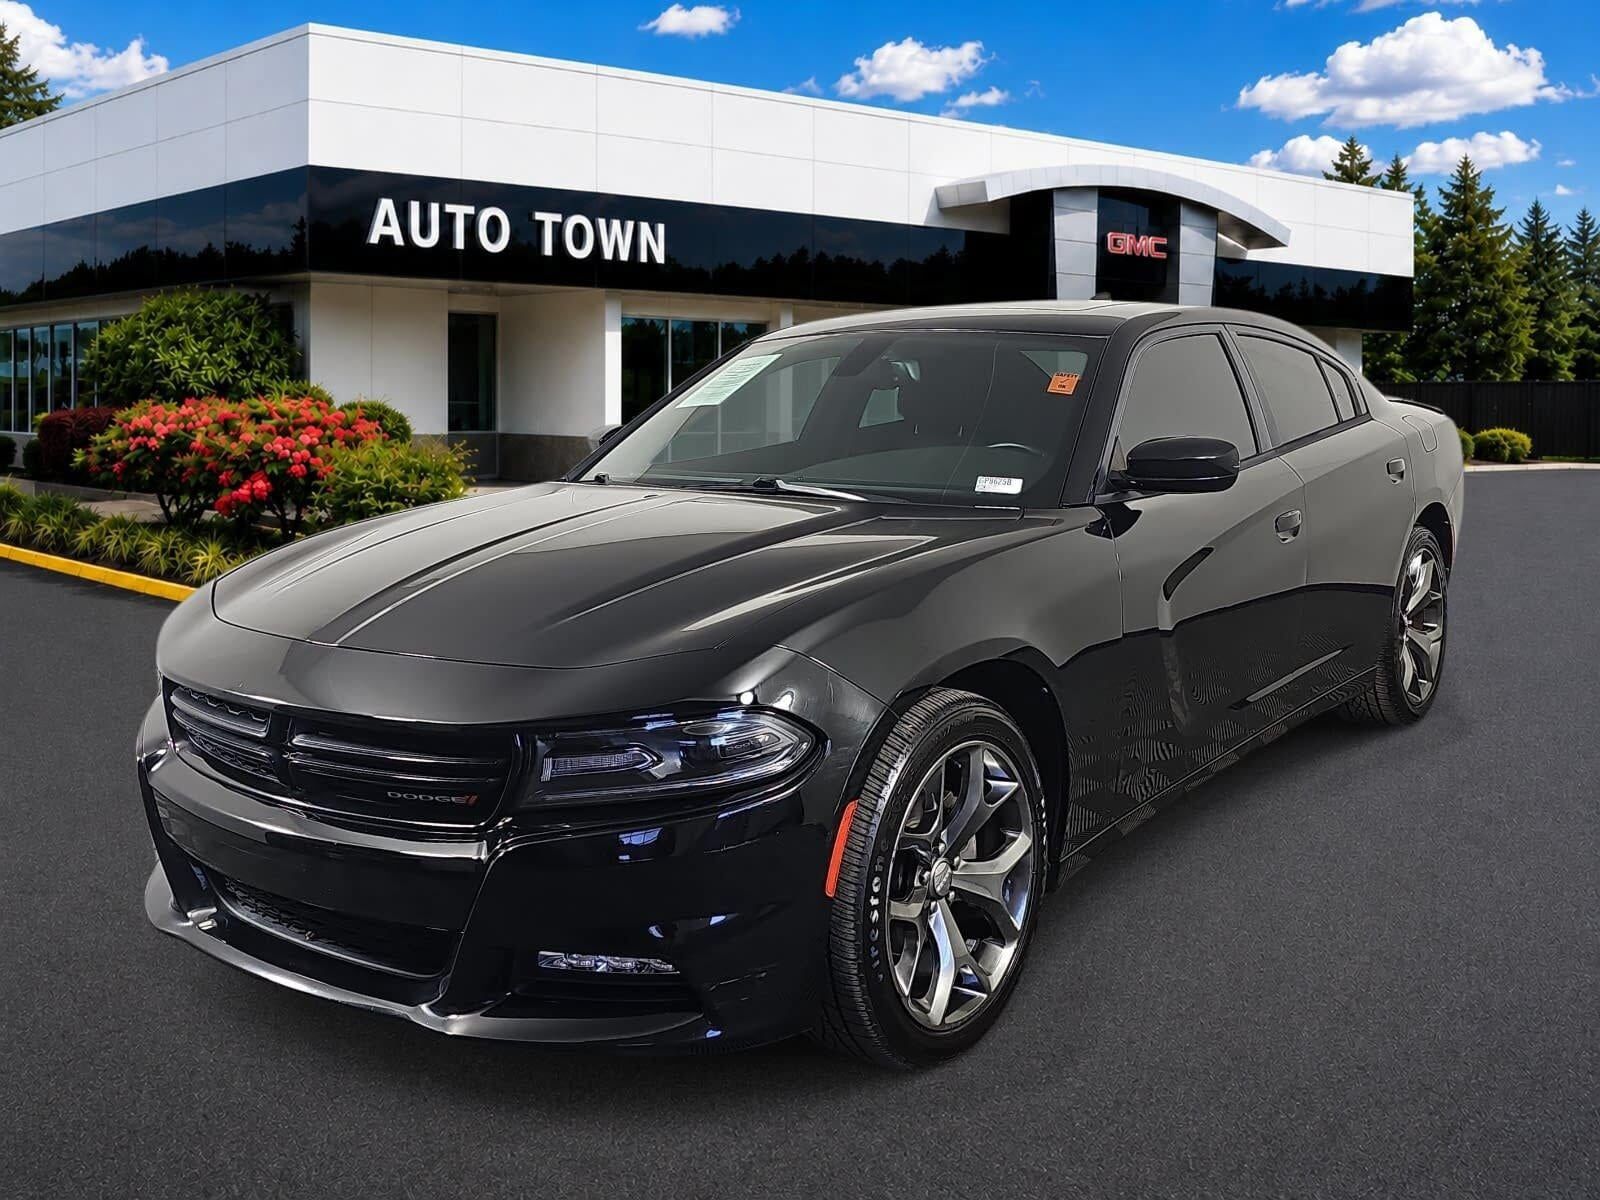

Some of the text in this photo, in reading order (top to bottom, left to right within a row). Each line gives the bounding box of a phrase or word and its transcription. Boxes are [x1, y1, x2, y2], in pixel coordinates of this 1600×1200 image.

[366, 197, 665, 264] AUTO TOWN
[1107, 231, 1167, 258] GMC
[387, 791, 466, 804] DODGE
